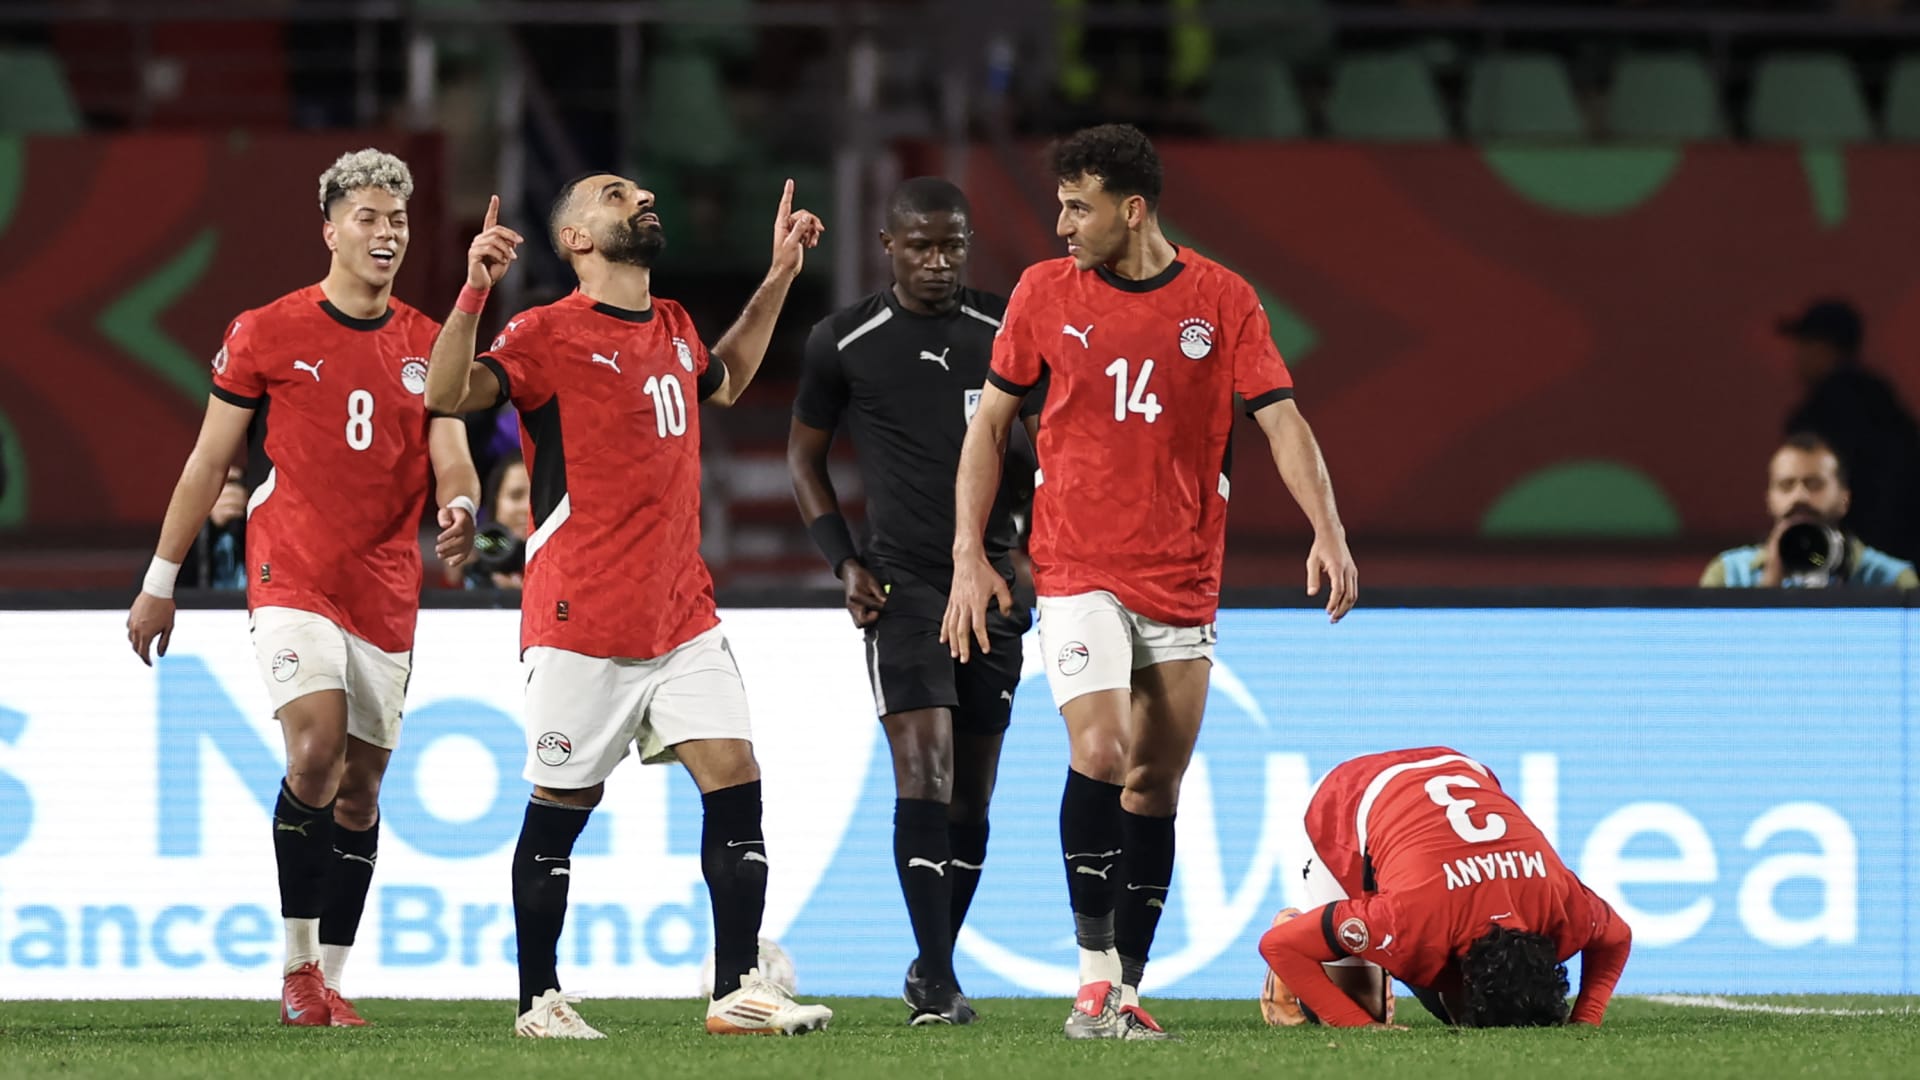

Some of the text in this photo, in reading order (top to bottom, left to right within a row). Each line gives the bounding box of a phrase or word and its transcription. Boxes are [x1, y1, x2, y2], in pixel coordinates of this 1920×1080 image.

[345, 389, 374, 451] 8
[643, 373, 687, 438] 10
[1105, 357, 1163, 423] 14
[1424, 774, 1508, 843] 3
[1442, 850, 1547, 891] M.HANY
[0, 882, 709, 969] ance Brnd
